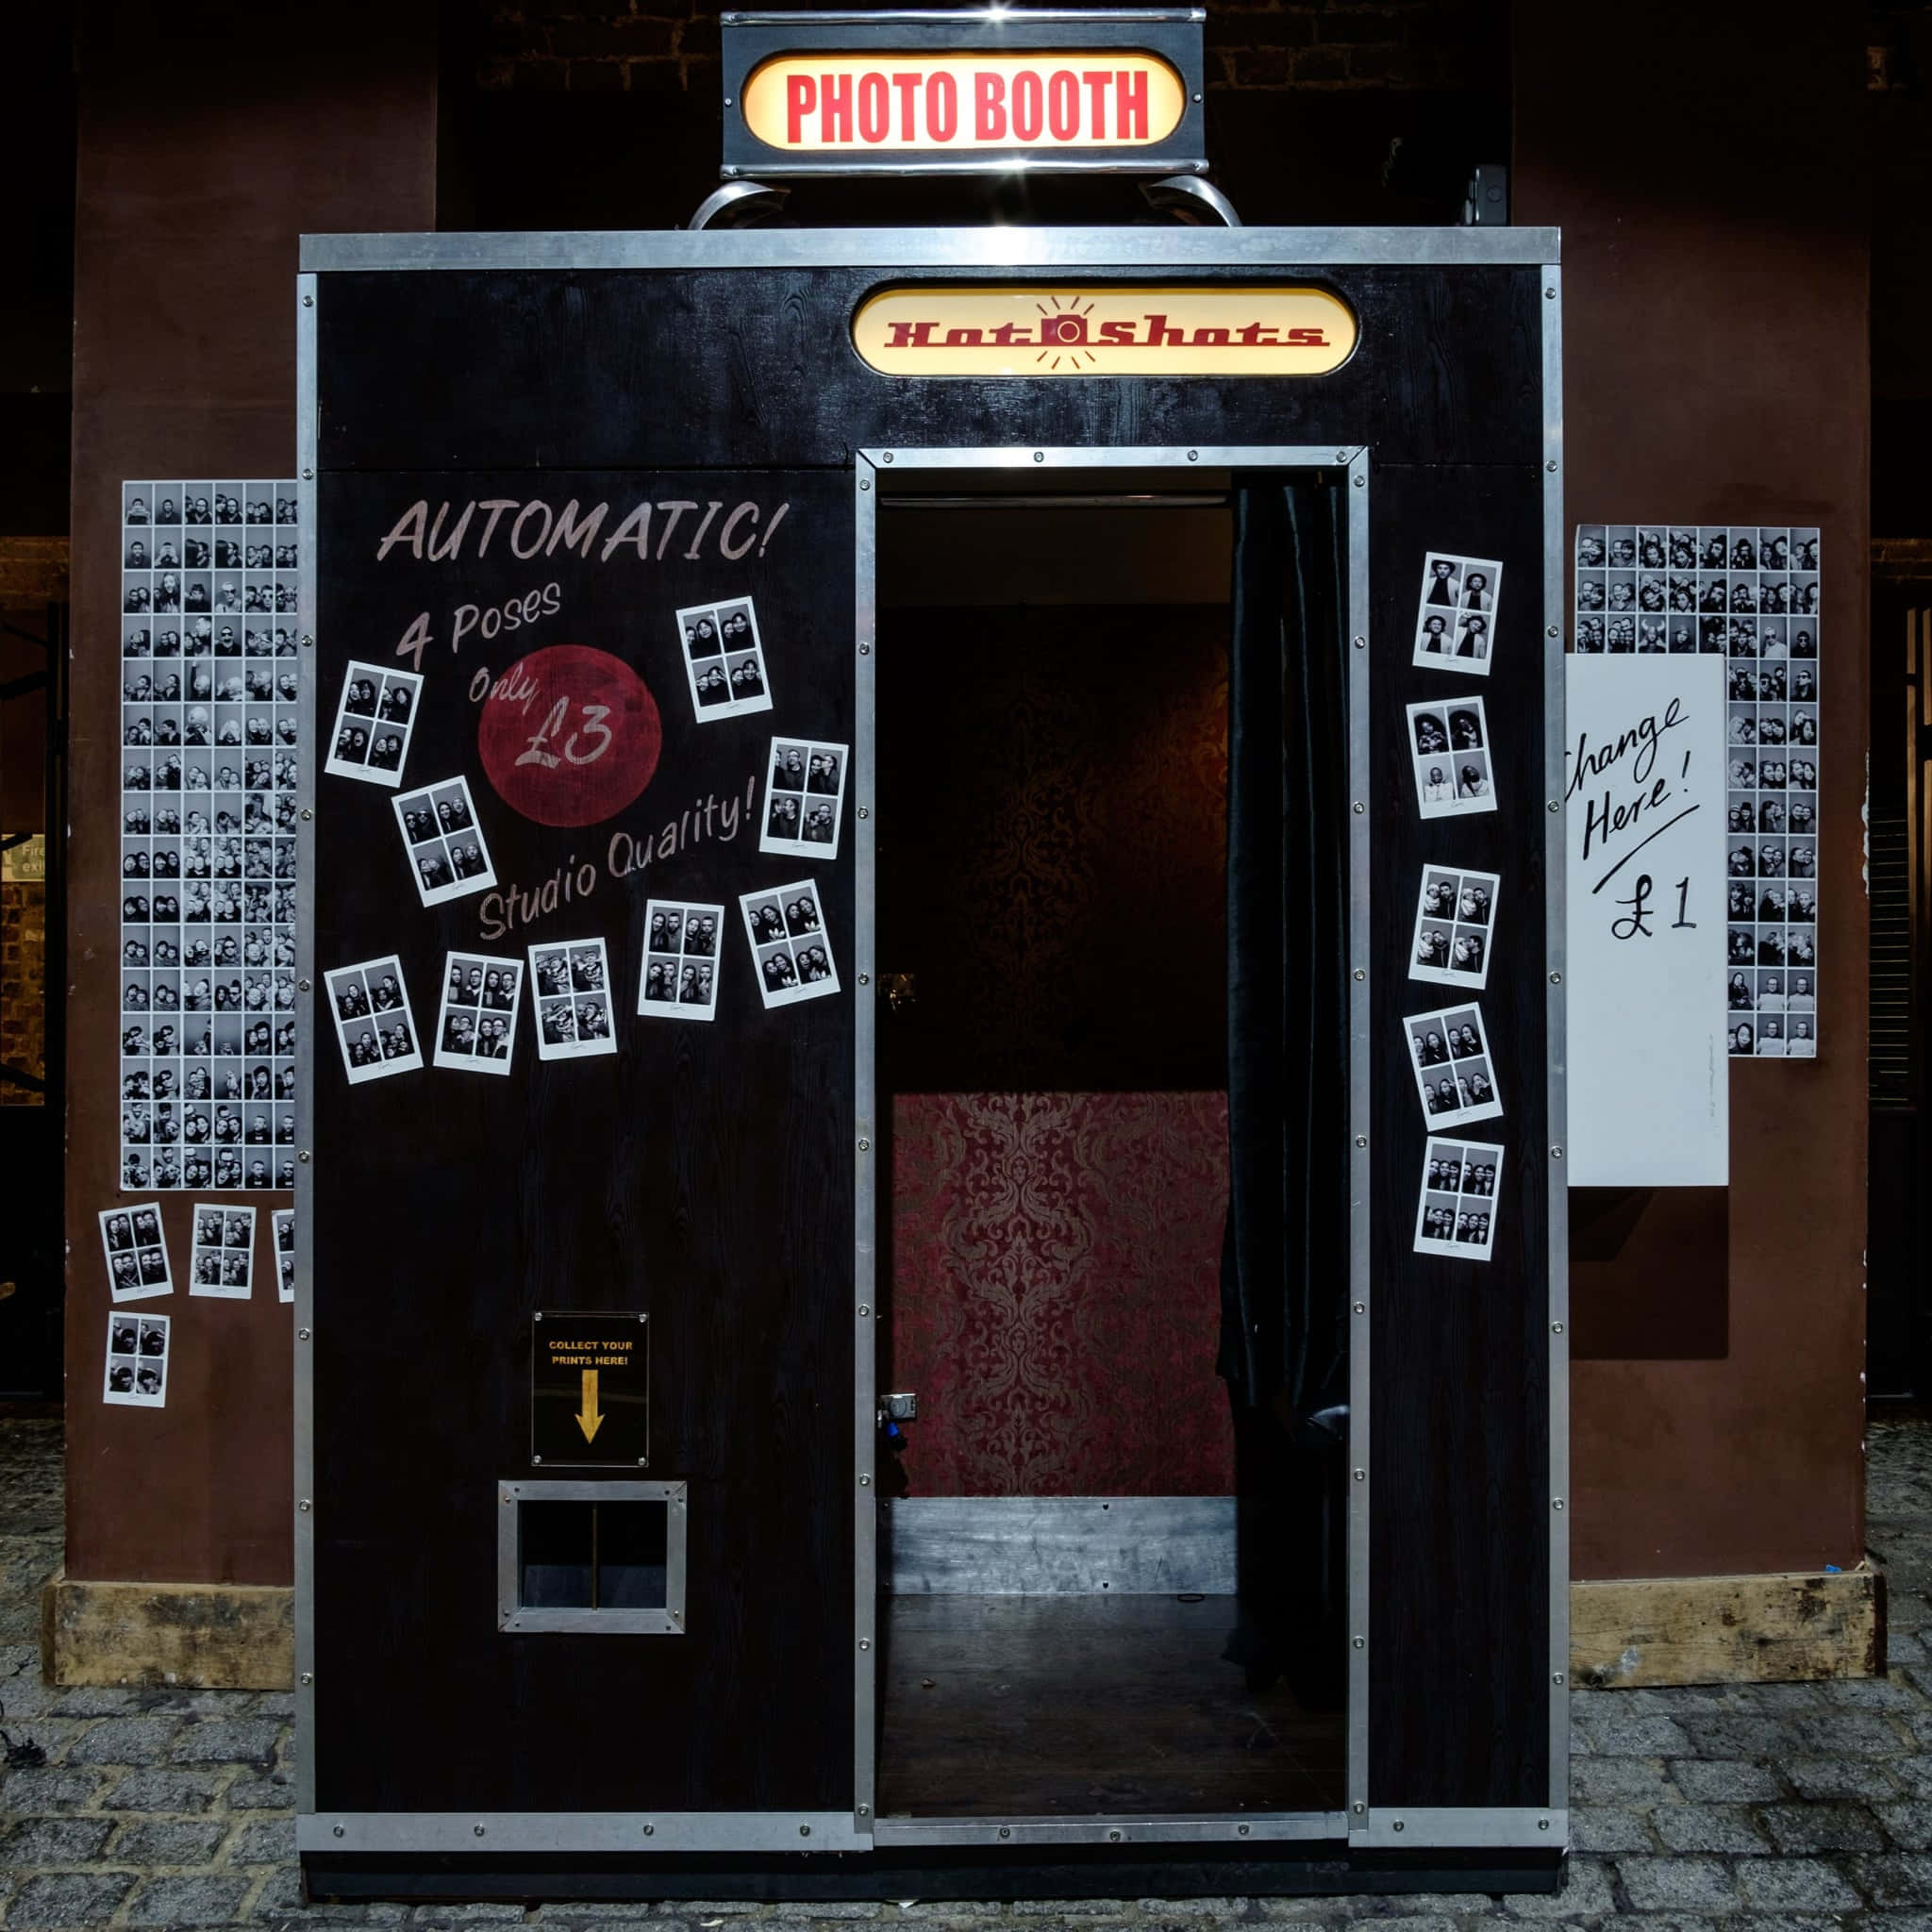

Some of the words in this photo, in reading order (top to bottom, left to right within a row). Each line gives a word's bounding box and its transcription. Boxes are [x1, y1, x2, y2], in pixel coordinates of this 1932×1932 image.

[787, 72, 958, 143] PHOTO
[974, 71, 1149, 141] BOOTH
[884, 322, 1036, 347] Hot
[1096, 315, 1330, 346] Shots
[377, 499, 790, 562] AUTOMATIC!
[396, 612, 433, 672] 4
[452, 582, 561, 653] Poses
[469, 662, 541, 716] Only
[514, 696, 612, 769] £3
[479, 855, 596, 941] Studio
[608, 775, 756, 878] Quality!
[549, 1341, 598, 1350] COLLECT
[602, 1341, 633, 1351] YOUR
[552, 1357, 592, 1366] PRINTS
[595, 1357, 628, 1366] HERE!
